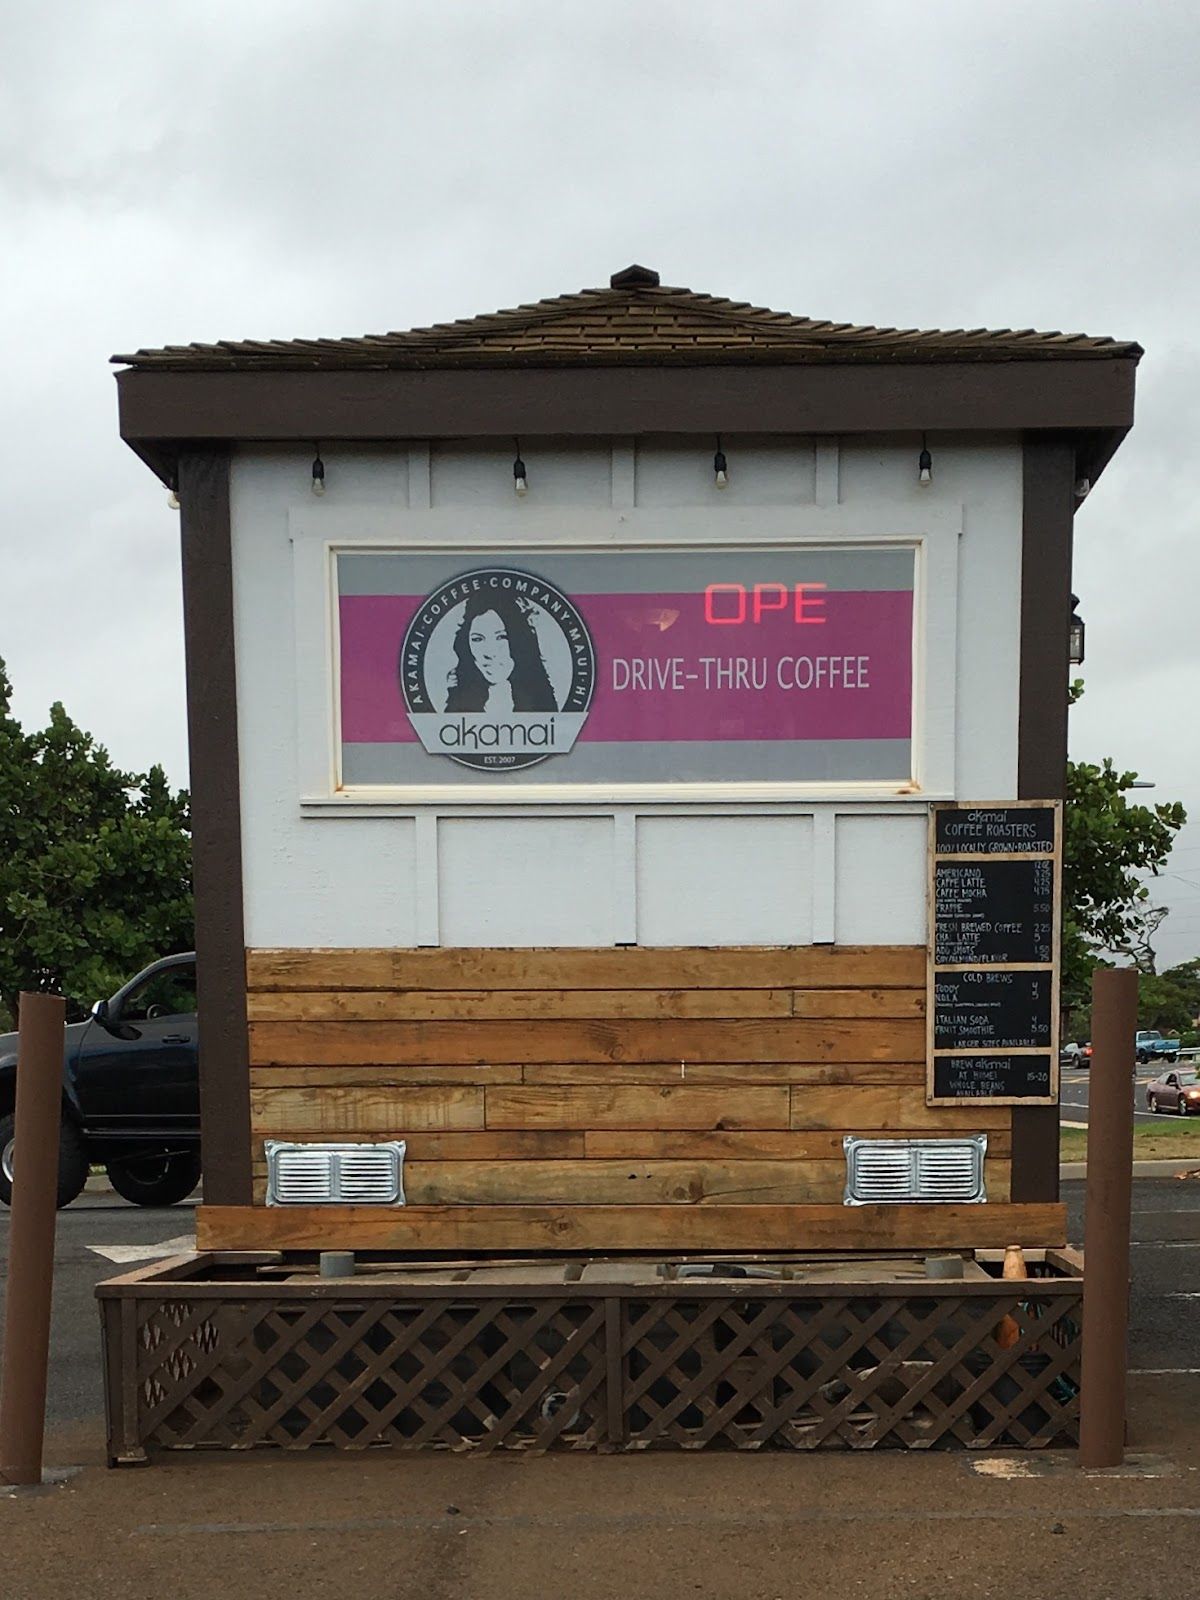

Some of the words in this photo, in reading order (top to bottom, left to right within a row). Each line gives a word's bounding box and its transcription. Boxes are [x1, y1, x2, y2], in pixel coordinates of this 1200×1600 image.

[704, 583, 828, 625] OPE
[408, 631, 425, 704] AKAMAI
[422, 579, 481, 624] COFFEE
[489, 577, 570, 621] COMPANY
[568, 628, 588, 676] MAUI
[612, 657, 768, 690] DRIVE-THRU
[777, 656, 870, 689] COFFEE
[439, 717, 555, 749] akamai
[945, 824, 982, 837] COFFEE
[986, 823, 1037, 837] ROASTERS
[936, 868, 982, 878] AMERICANO
[961, 878, 986, 888] LATTE
[962, 888, 988, 898] MOCHA
[961, 921, 992, 933] BREWED
[994, 922, 1023, 934] COFFEE
[956, 932, 981, 943] LATTE
[962, 972, 983, 984] COLD
[935, 1014, 968, 1025] ITALIAN
[969, 1014, 990, 1026] SODA
[951, 1059, 974, 1070] BREW
